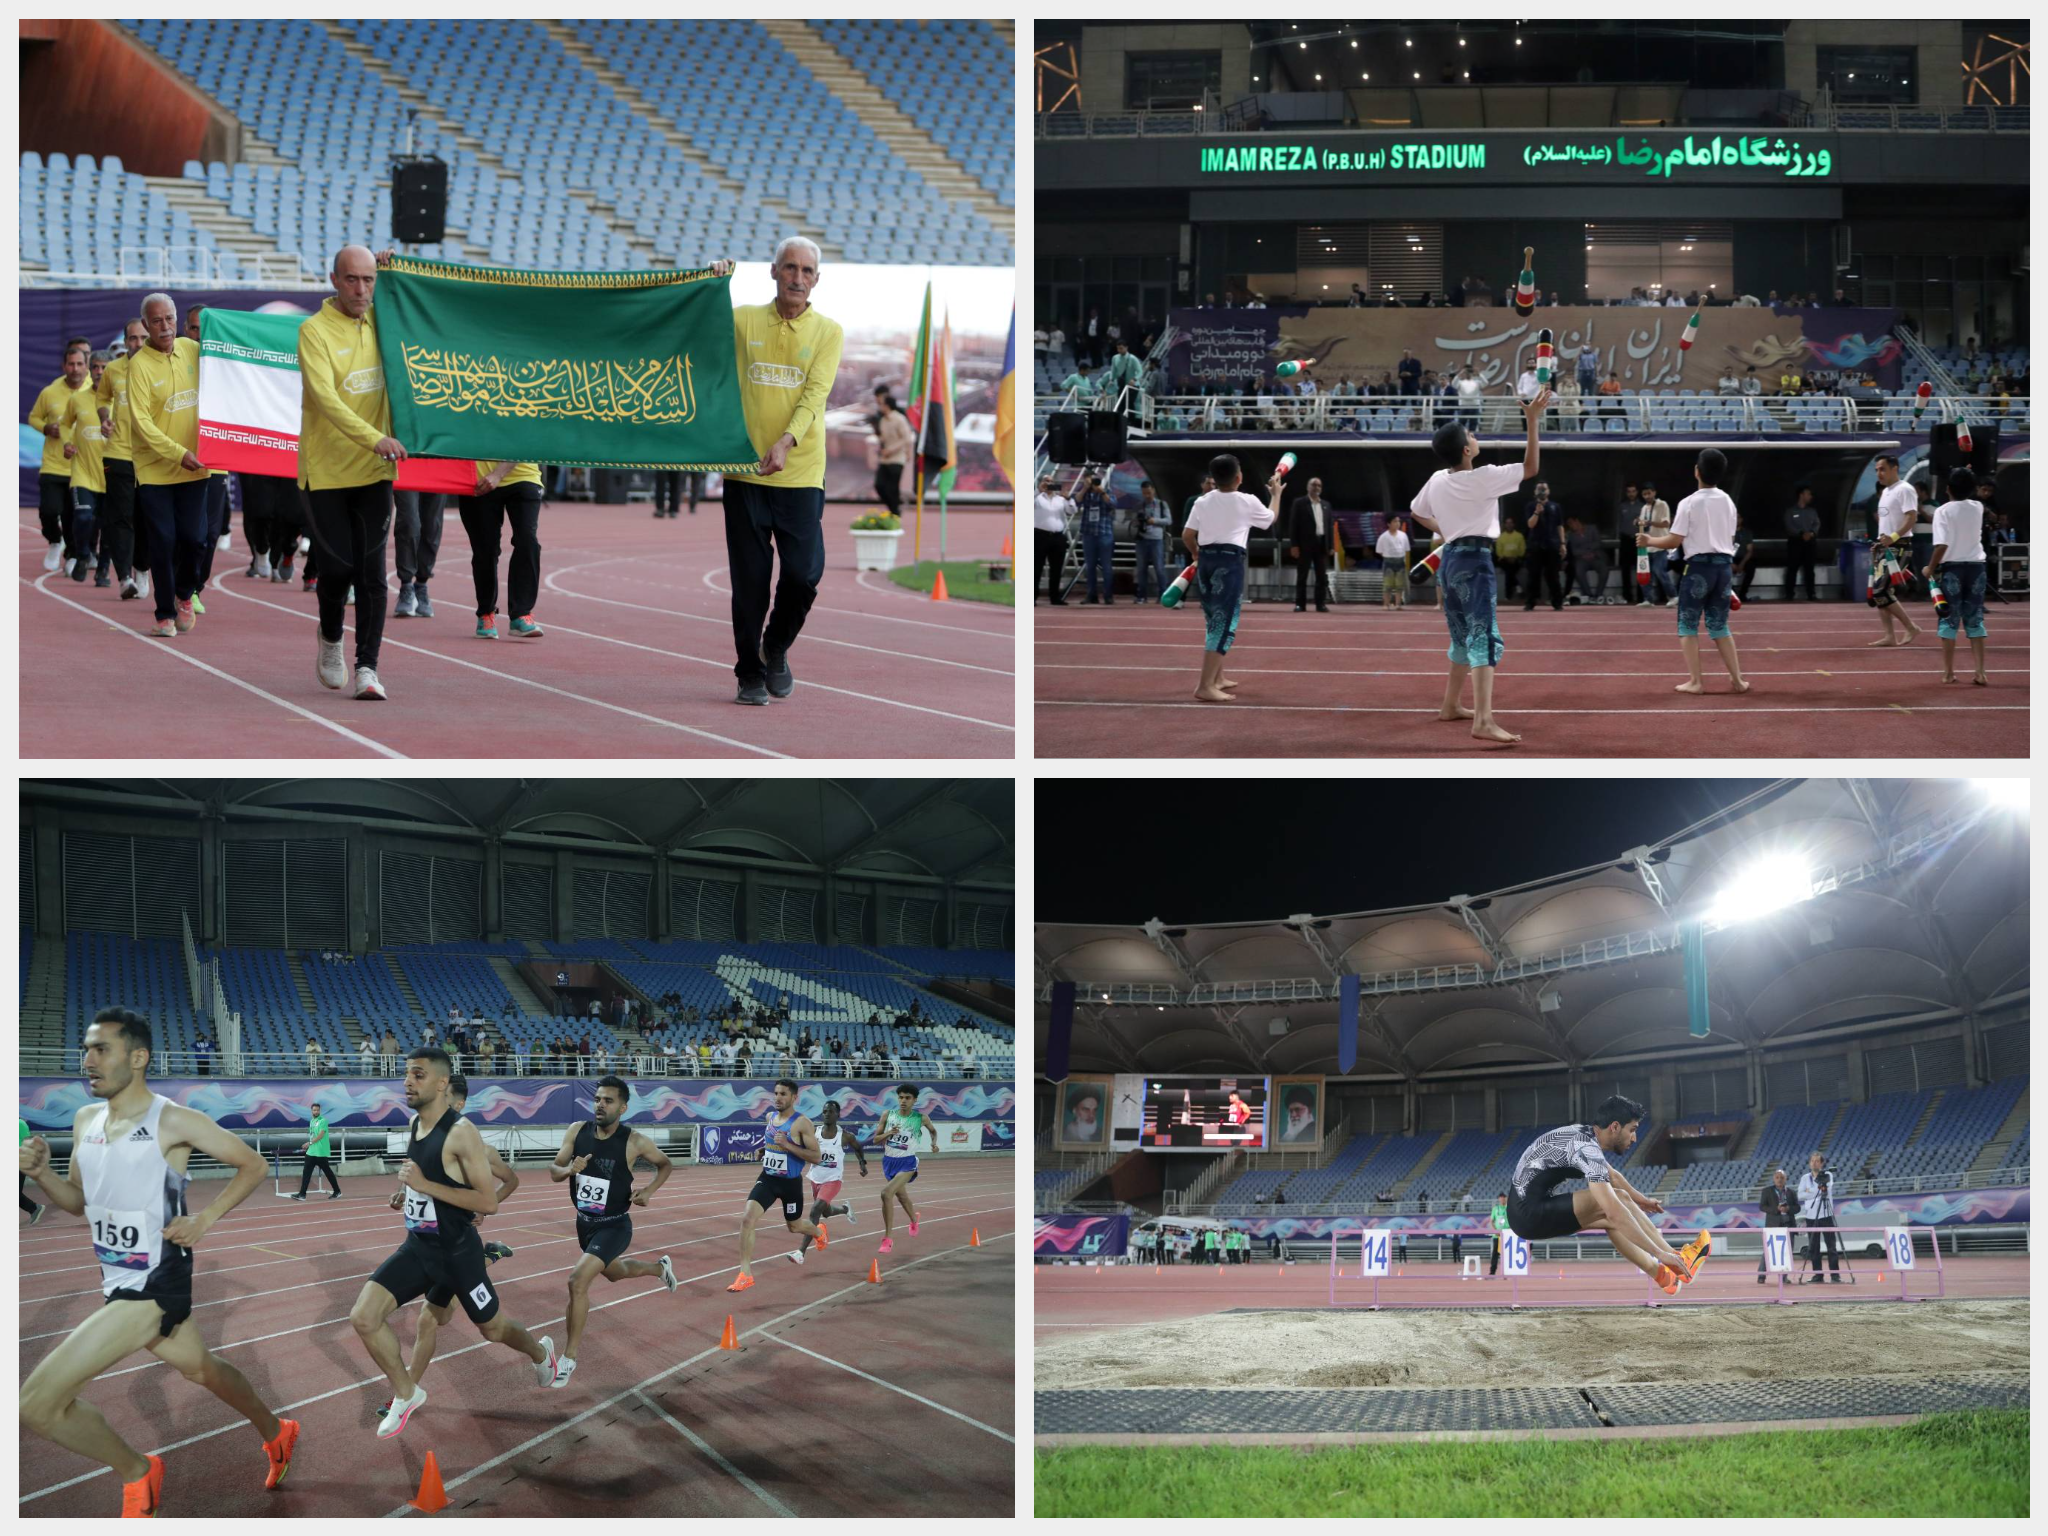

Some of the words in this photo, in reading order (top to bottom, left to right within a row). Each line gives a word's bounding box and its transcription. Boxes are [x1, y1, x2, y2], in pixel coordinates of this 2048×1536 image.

[1201, 147, 1257, 172] IMAM
[1259, 146, 1318, 171] REZA
[1322, 148, 1386, 171] (P.B.U.H)
[1389, 144, 1486, 169] STADIUM
[1616, 136, 1664, 176] رضا
[1664, 136, 1722, 178] امام
[1722, 137, 1832, 176] ورزشگاه
[1190, 363, 1214, 380] رضا
[1214, 363, 1240, 380] امام
[1240, 364, 1266, 381] جام
[764, 1157, 785, 1169] 107
[94, 1220, 139, 1249] 159
[1888, 1233, 1911, 1265] 18
[1364, 1235, 1387, 1270] 14
[1504, 1235, 1528, 1270] 15
[1766, 1234, 1787, 1266] 17
[476, 1289, 487, 1303] 6
